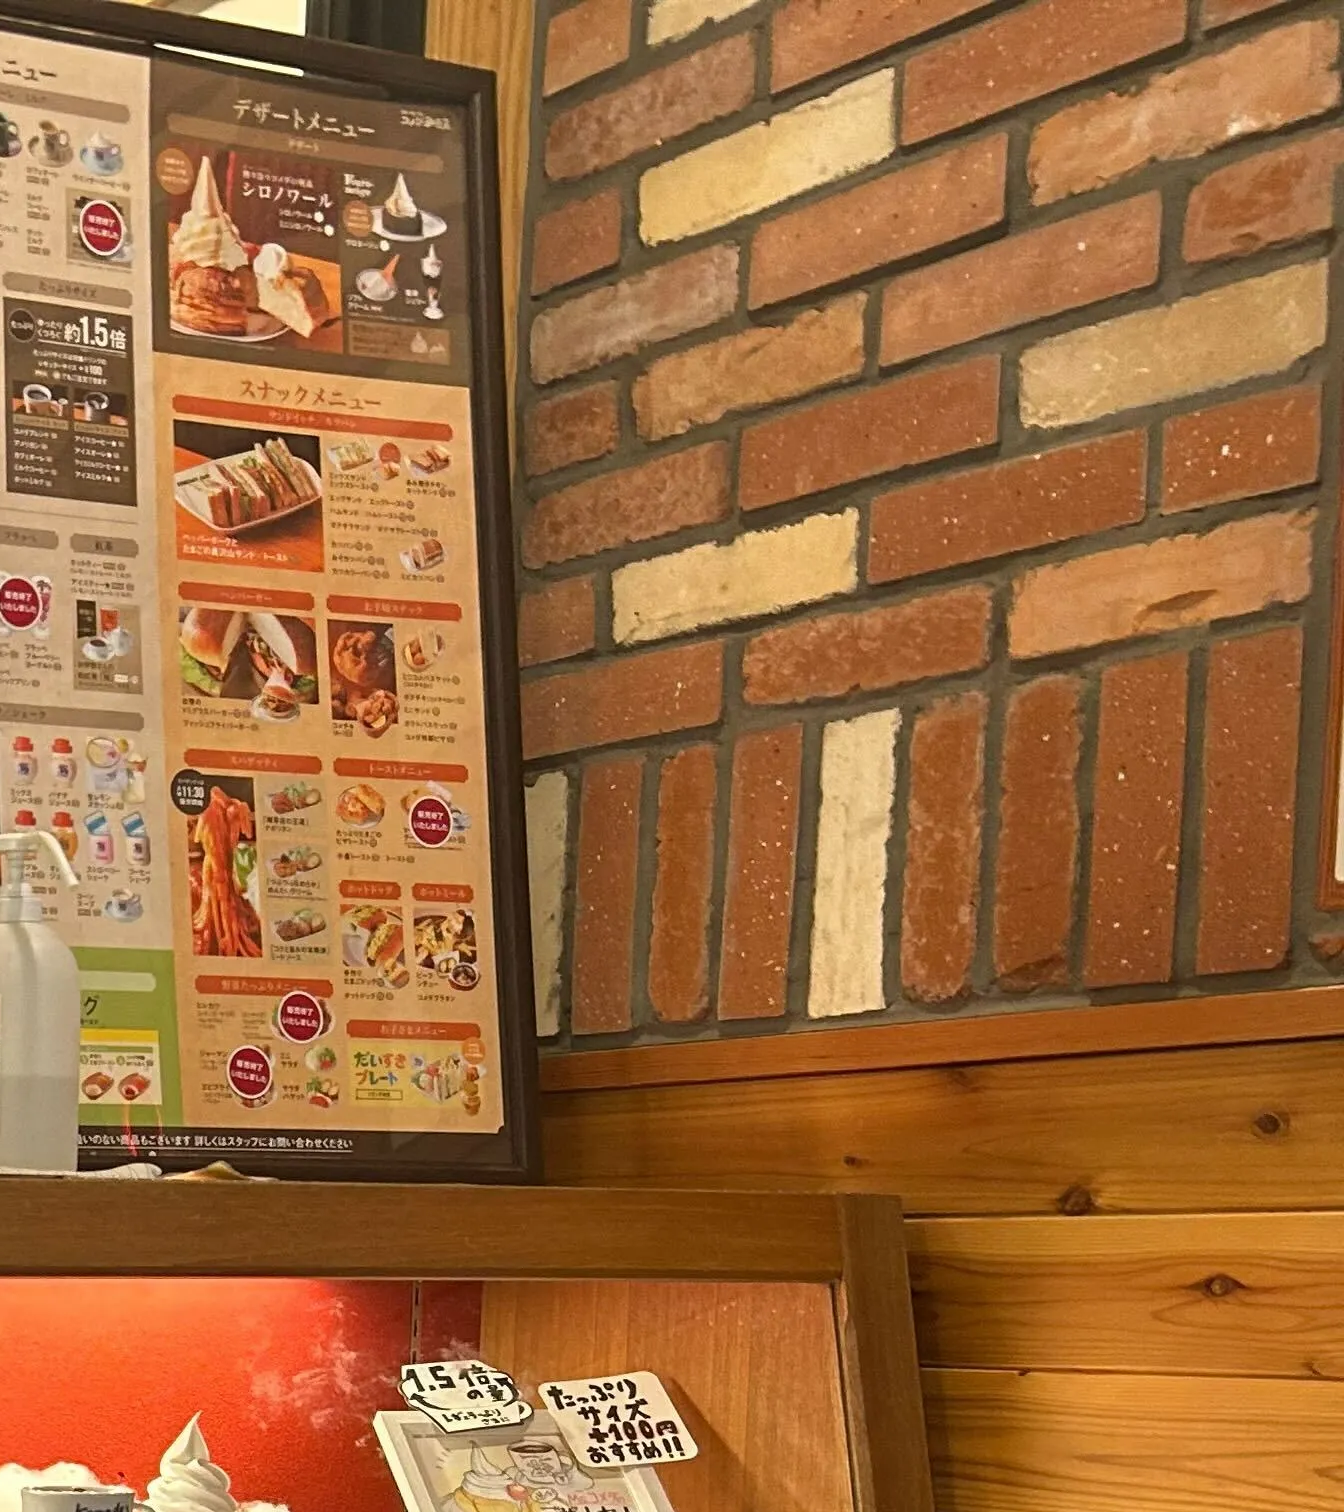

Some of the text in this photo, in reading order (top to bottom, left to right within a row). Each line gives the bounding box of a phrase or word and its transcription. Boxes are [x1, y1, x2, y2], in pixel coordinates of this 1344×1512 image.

[232, 99, 375, 138] デザートメニュー
[241, 181, 334, 211] シロノワール
[63, 315, 127, 351] 約1.5倍
[239, 379, 382, 411] スナックメニュー
[353, 1050, 407, 1069] だいすき
[355, 1069, 399, 1087] プレート
[404, 1363, 491, 1393] 1.5倍
[546, 1378, 639, 1412] たっぷり
[576, 1398, 653, 1427] サイズ
[587, 1419, 680, 1445] +100円
[585, 1436, 687, 1465] おすすめ!!
